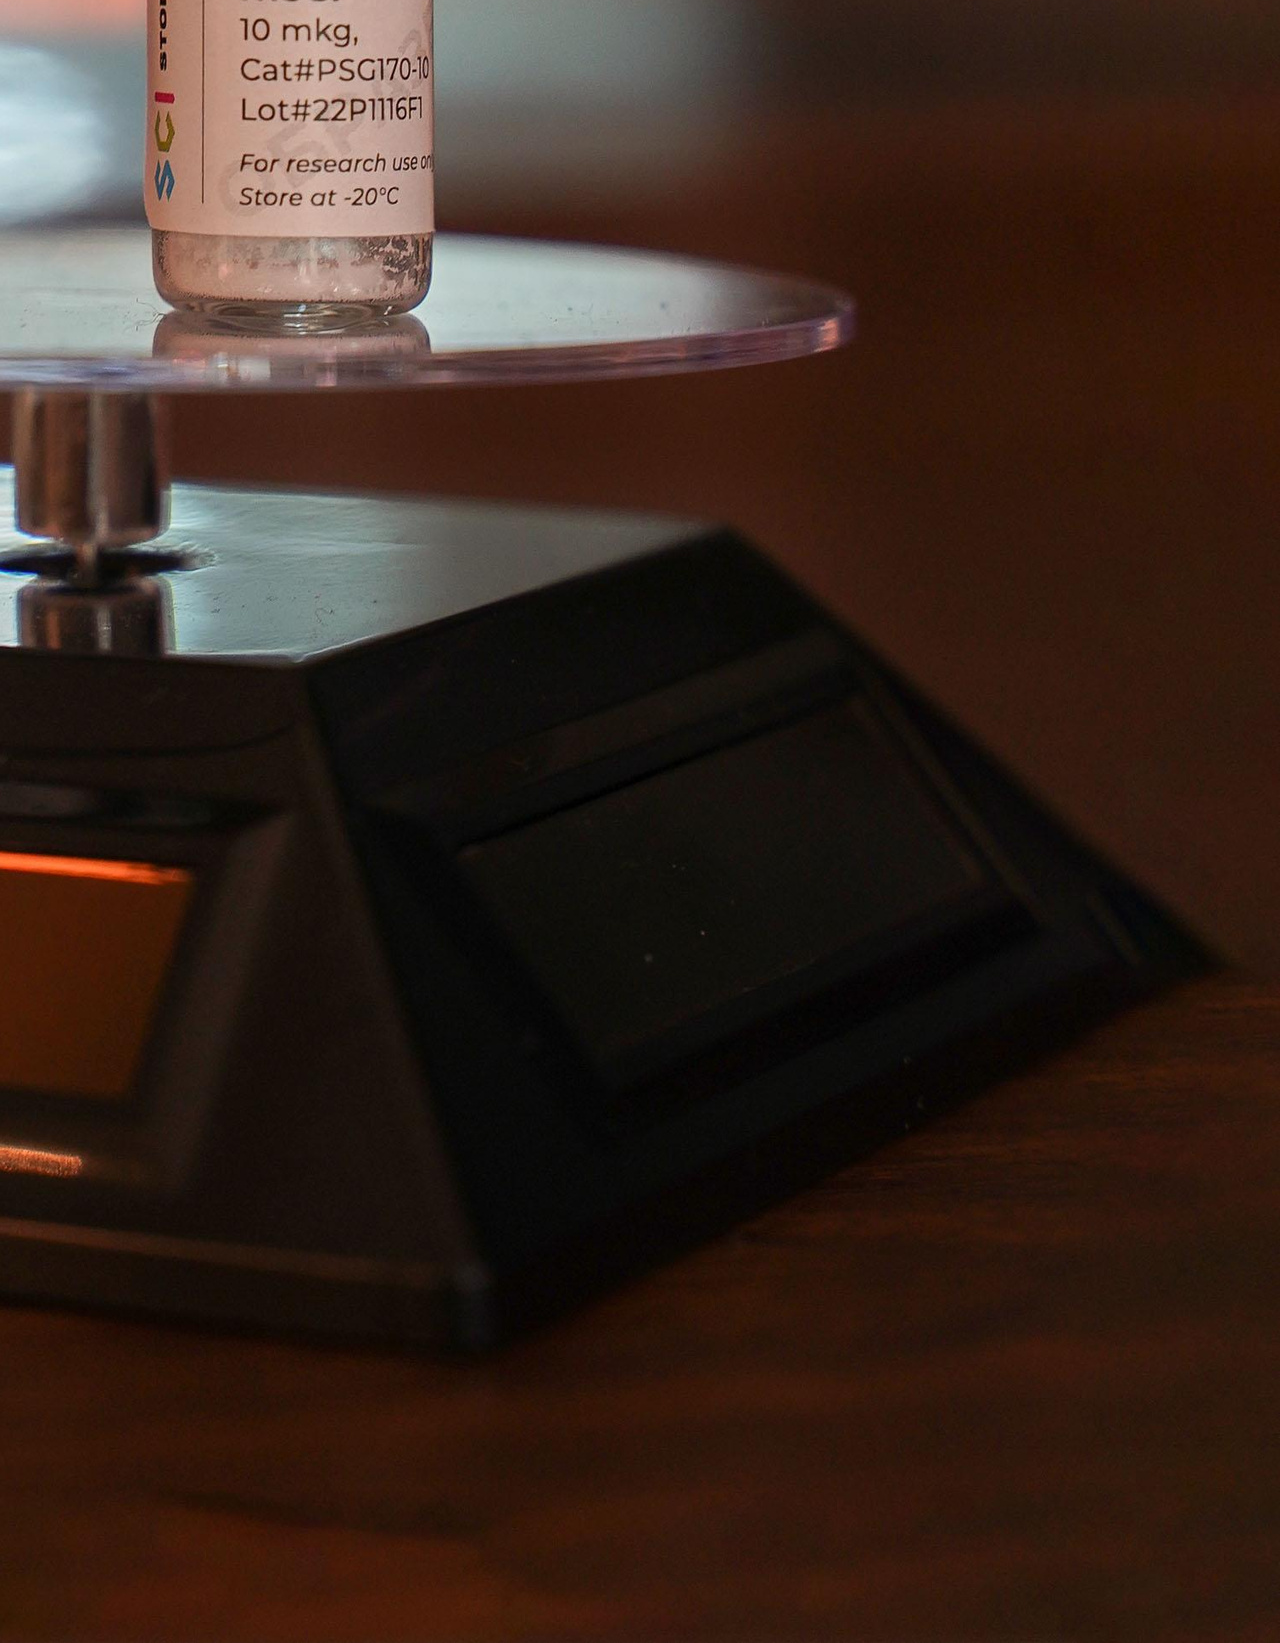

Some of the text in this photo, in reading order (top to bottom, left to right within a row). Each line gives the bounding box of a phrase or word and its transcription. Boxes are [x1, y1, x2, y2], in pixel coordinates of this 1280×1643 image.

[239, 18, 359, 47] 10 mkg,
[240, 56, 430, 82] Cat#PSG170-10
[240, 96, 423, 122] Lot#22P1116F1
[154, 91, 175, 202] SCI
[239, 153, 280, 173] For
[286, 153, 386, 173] research
[392, 156, 418, 171] use
[239, 186, 303, 207] Store
[310, 190, 337, 207] at
